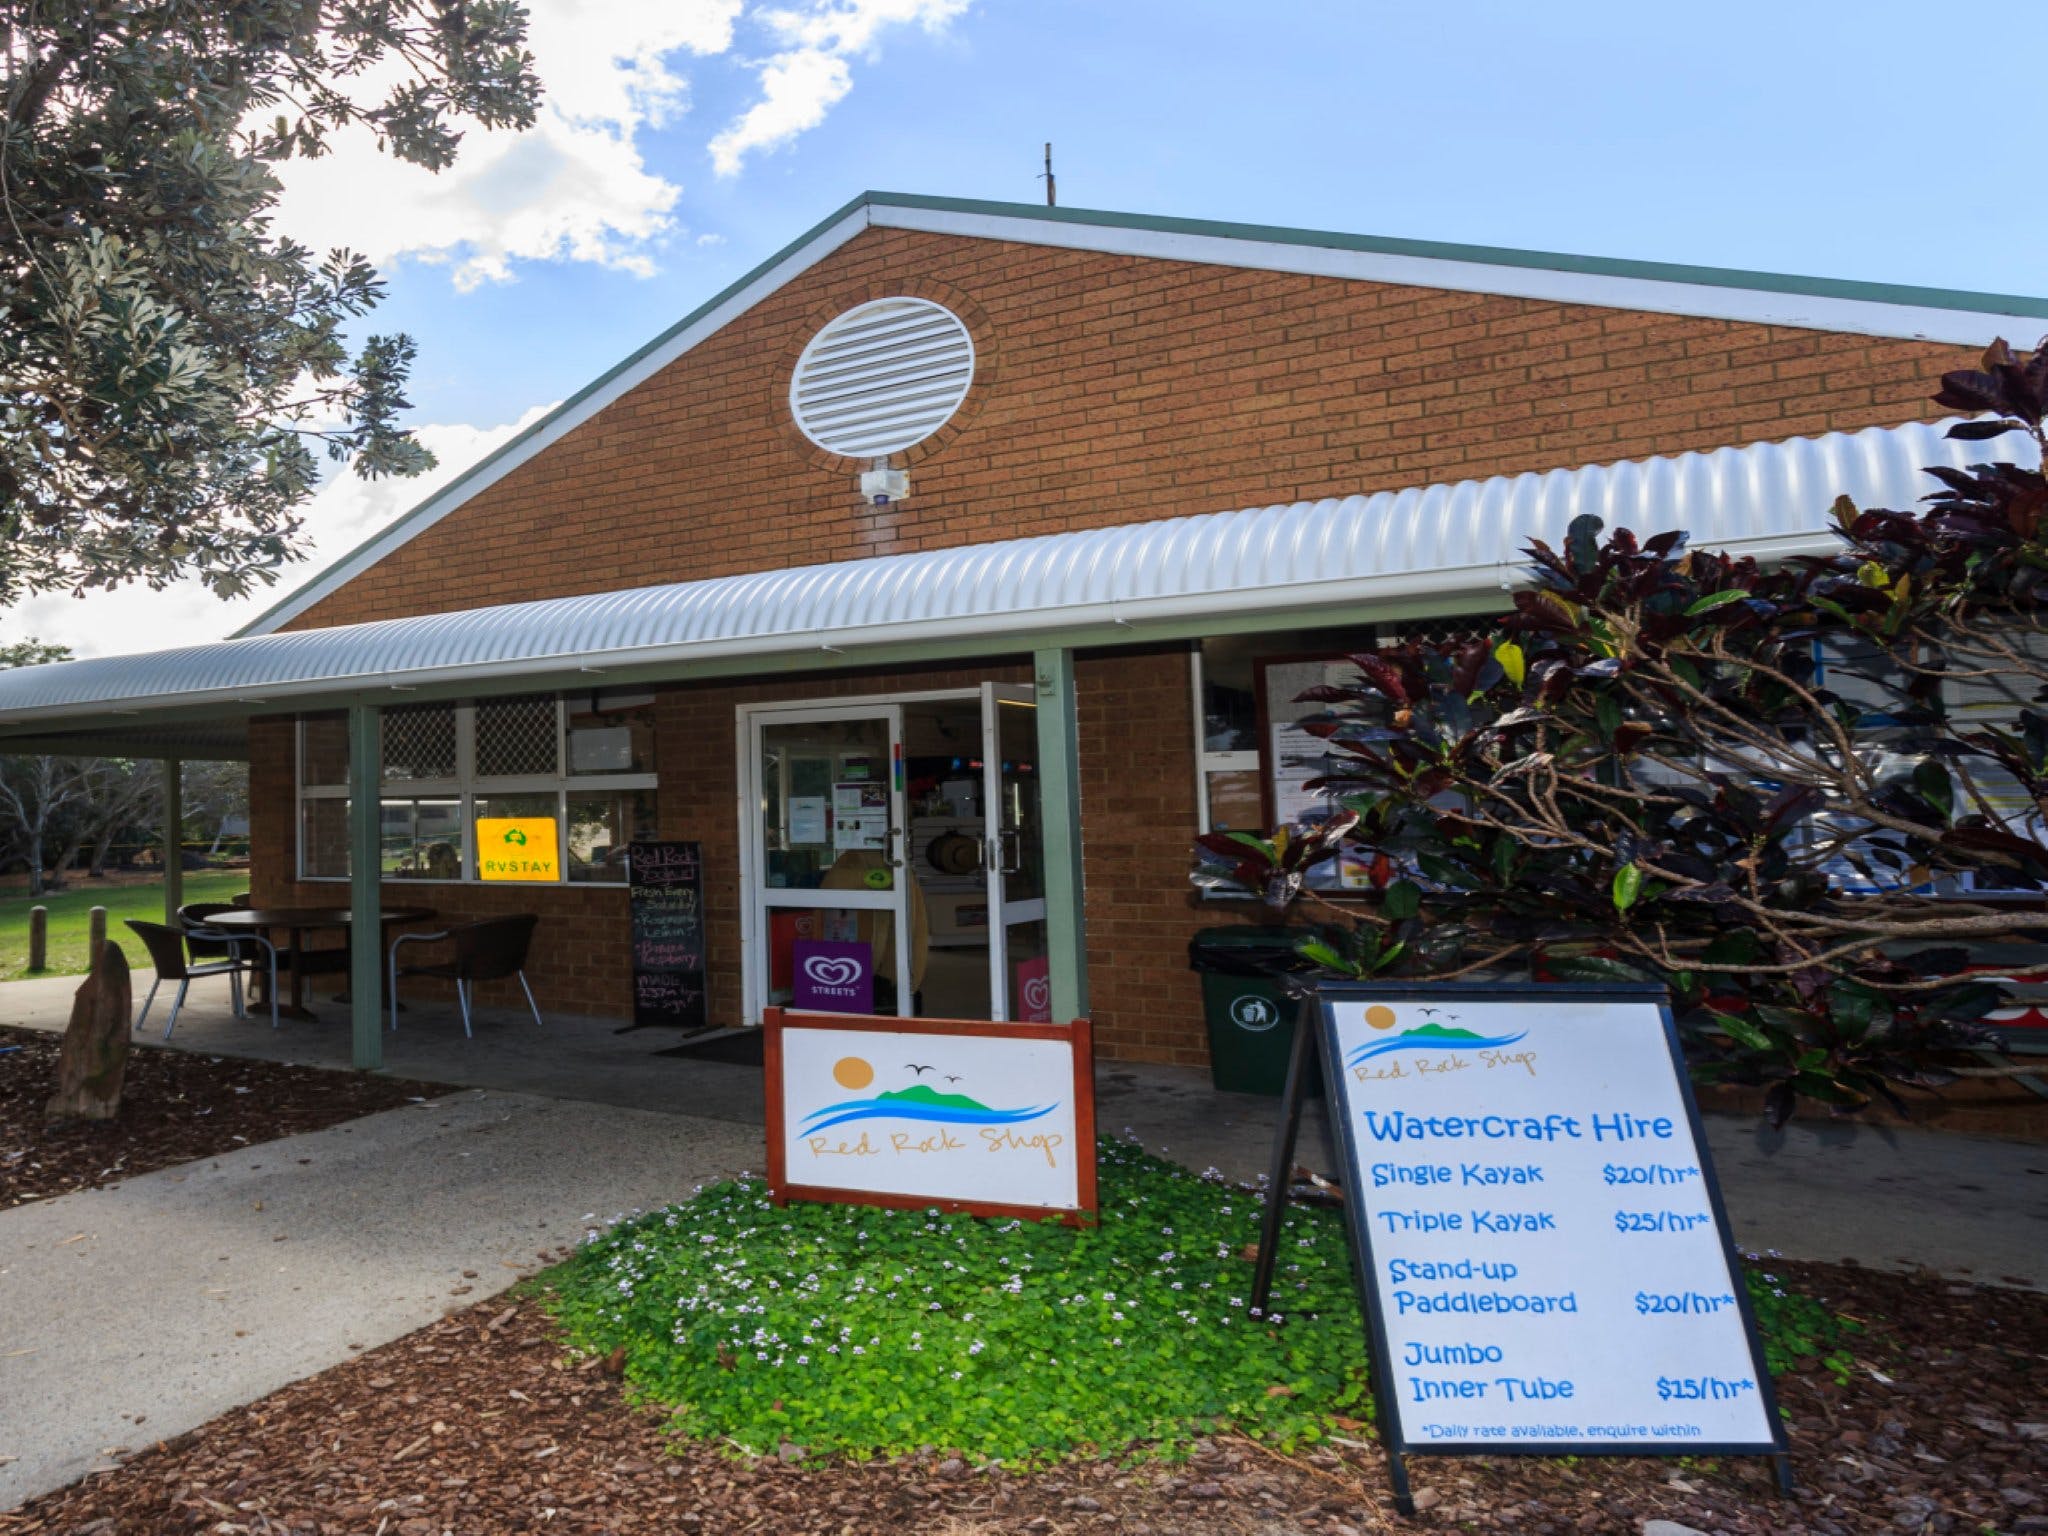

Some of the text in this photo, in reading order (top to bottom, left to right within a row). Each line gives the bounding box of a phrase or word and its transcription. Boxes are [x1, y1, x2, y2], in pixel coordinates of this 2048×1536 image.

[1353, 1050, 1538, 1083] Red Rock Shop
[1591, 1112, 1674, 1142] Hire
[807, 1127, 1064, 1169] Red Rock Shop
[1372, 1163, 1452, 1187] Single
[1461, 1164, 1544, 1186] Kayak
[1378, 1211, 1463, 1233] Triple
[1471, 1211, 1556, 1233] Kayak
[1388, 1258, 1518, 1283] Stand-up
[1393, 1291, 1578, 1315] Paddleboard
[1404, 1342, 1503, 1366] Jumbo
[1409, 1376, 1488, 1402] Inner
[1495, 1377, 1575, 1401] Tube
[1473, 1426, 1506, 1437] rate
[1587, 1425, 1648, 1438] enquire
[1651, 1424, 1701, 1437] within
